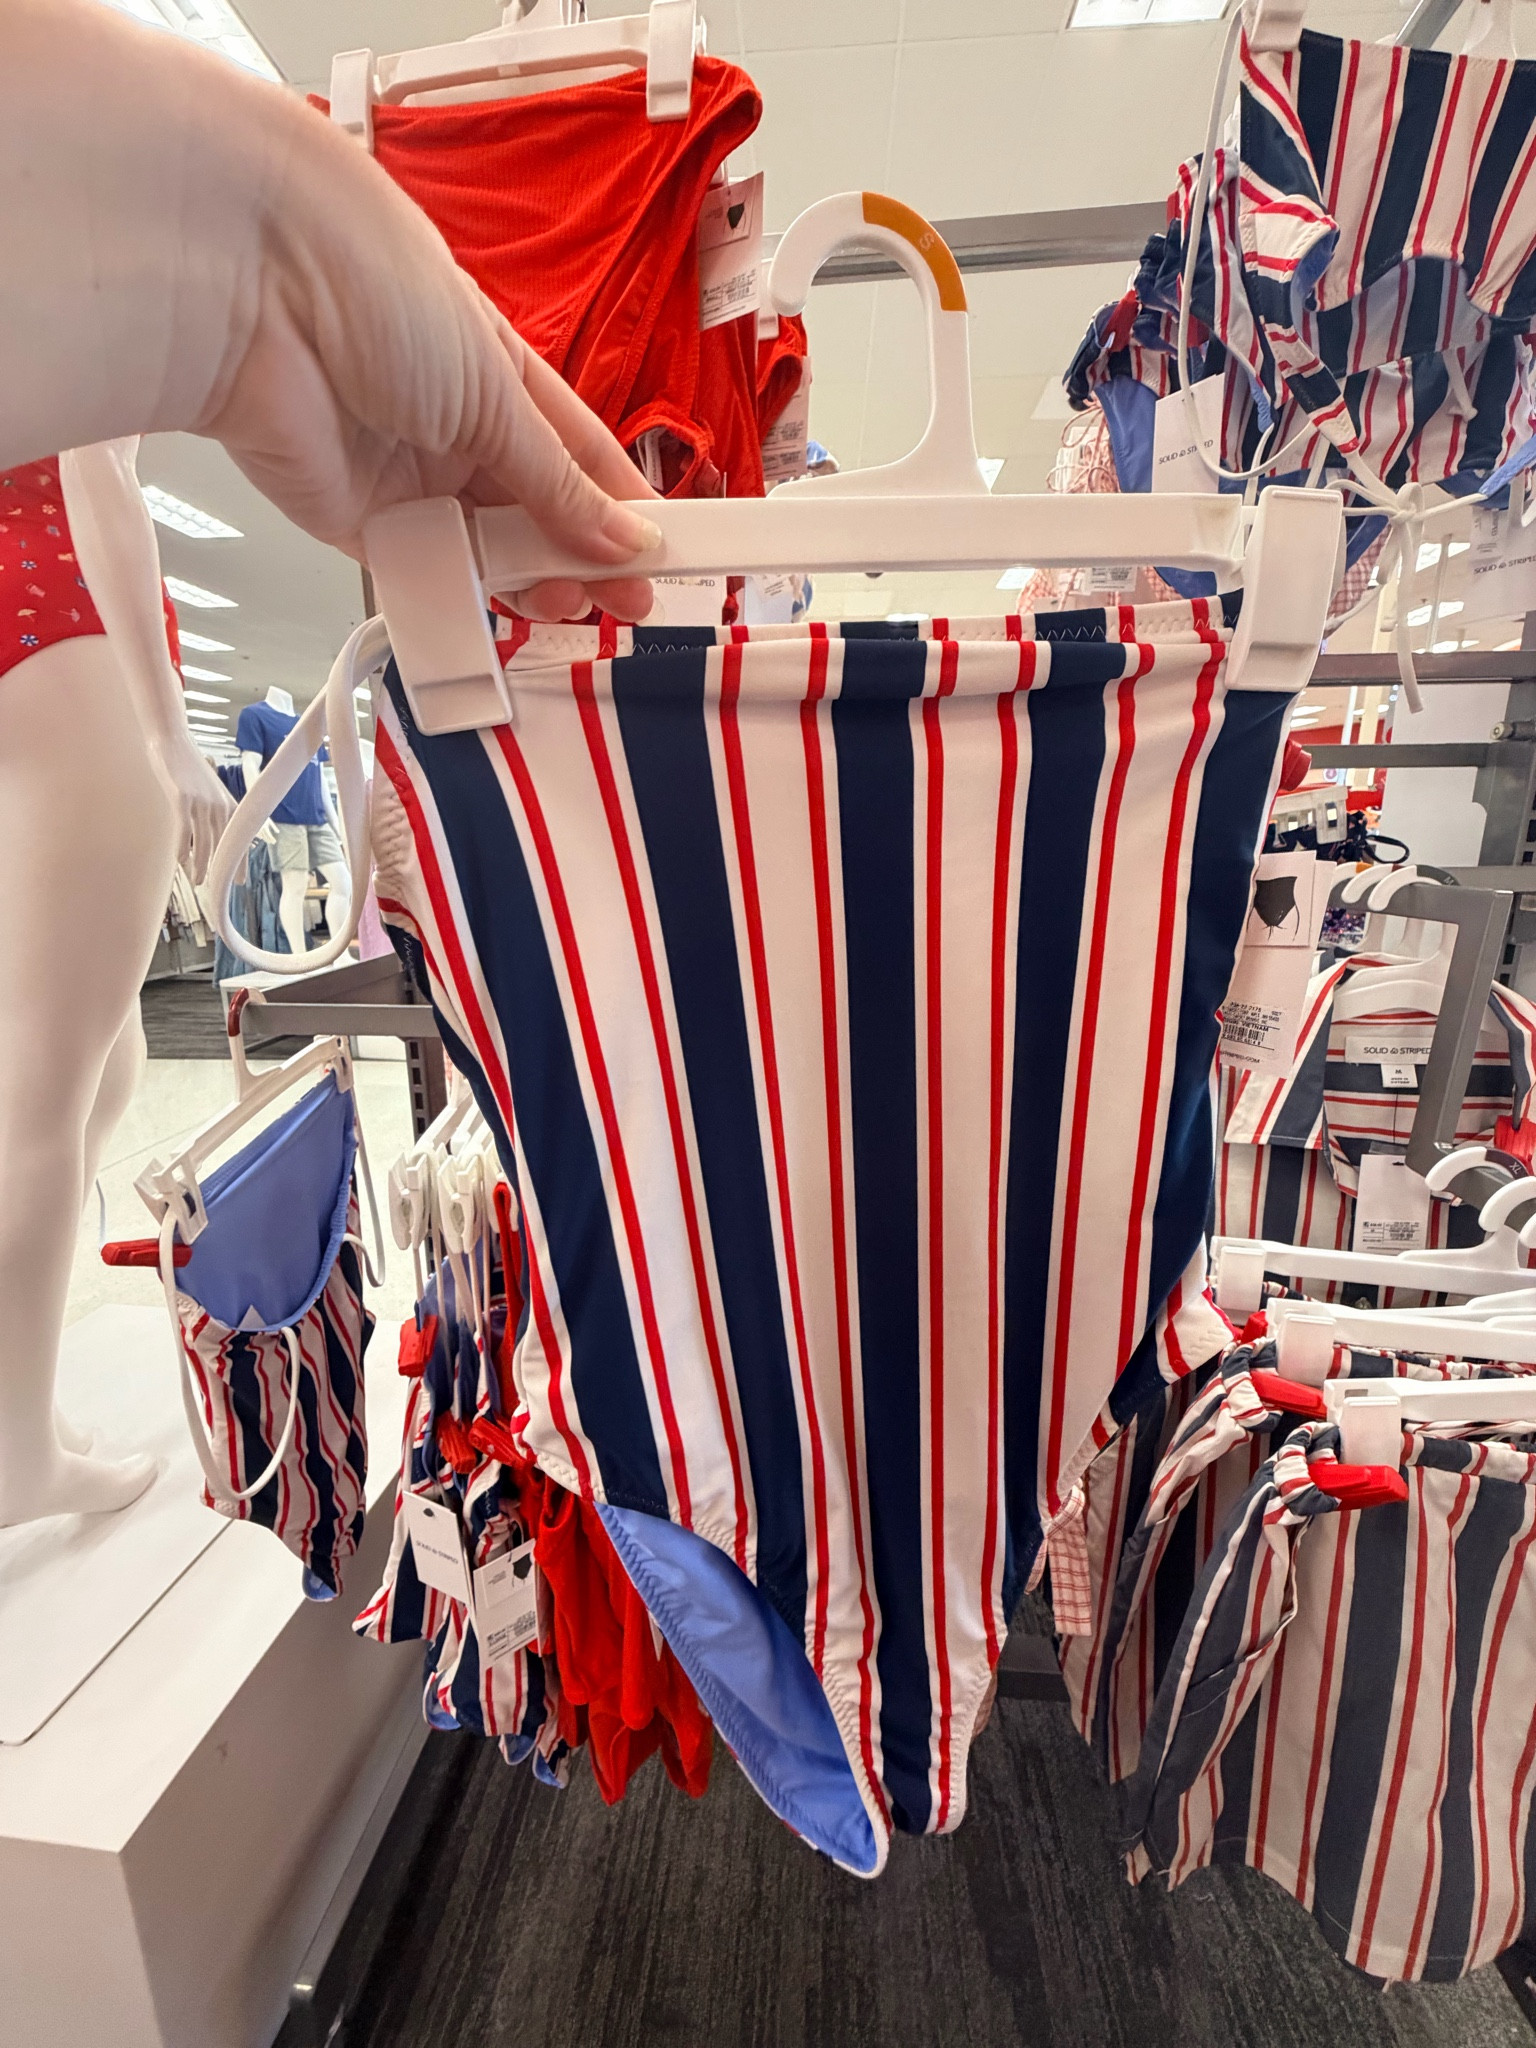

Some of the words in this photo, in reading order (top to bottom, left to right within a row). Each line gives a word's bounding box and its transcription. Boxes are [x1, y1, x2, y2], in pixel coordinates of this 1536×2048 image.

[920, 233, 934, 251] S
[1159, 452, 1178, 464] SOLID
[1473, 564, 1497, 575] SOLID
[1363, 1047, 1388, 1055] SOLID
[1390, 1047, 1398, 1055] &
[1509, 1161, 1522, 1174] XL
